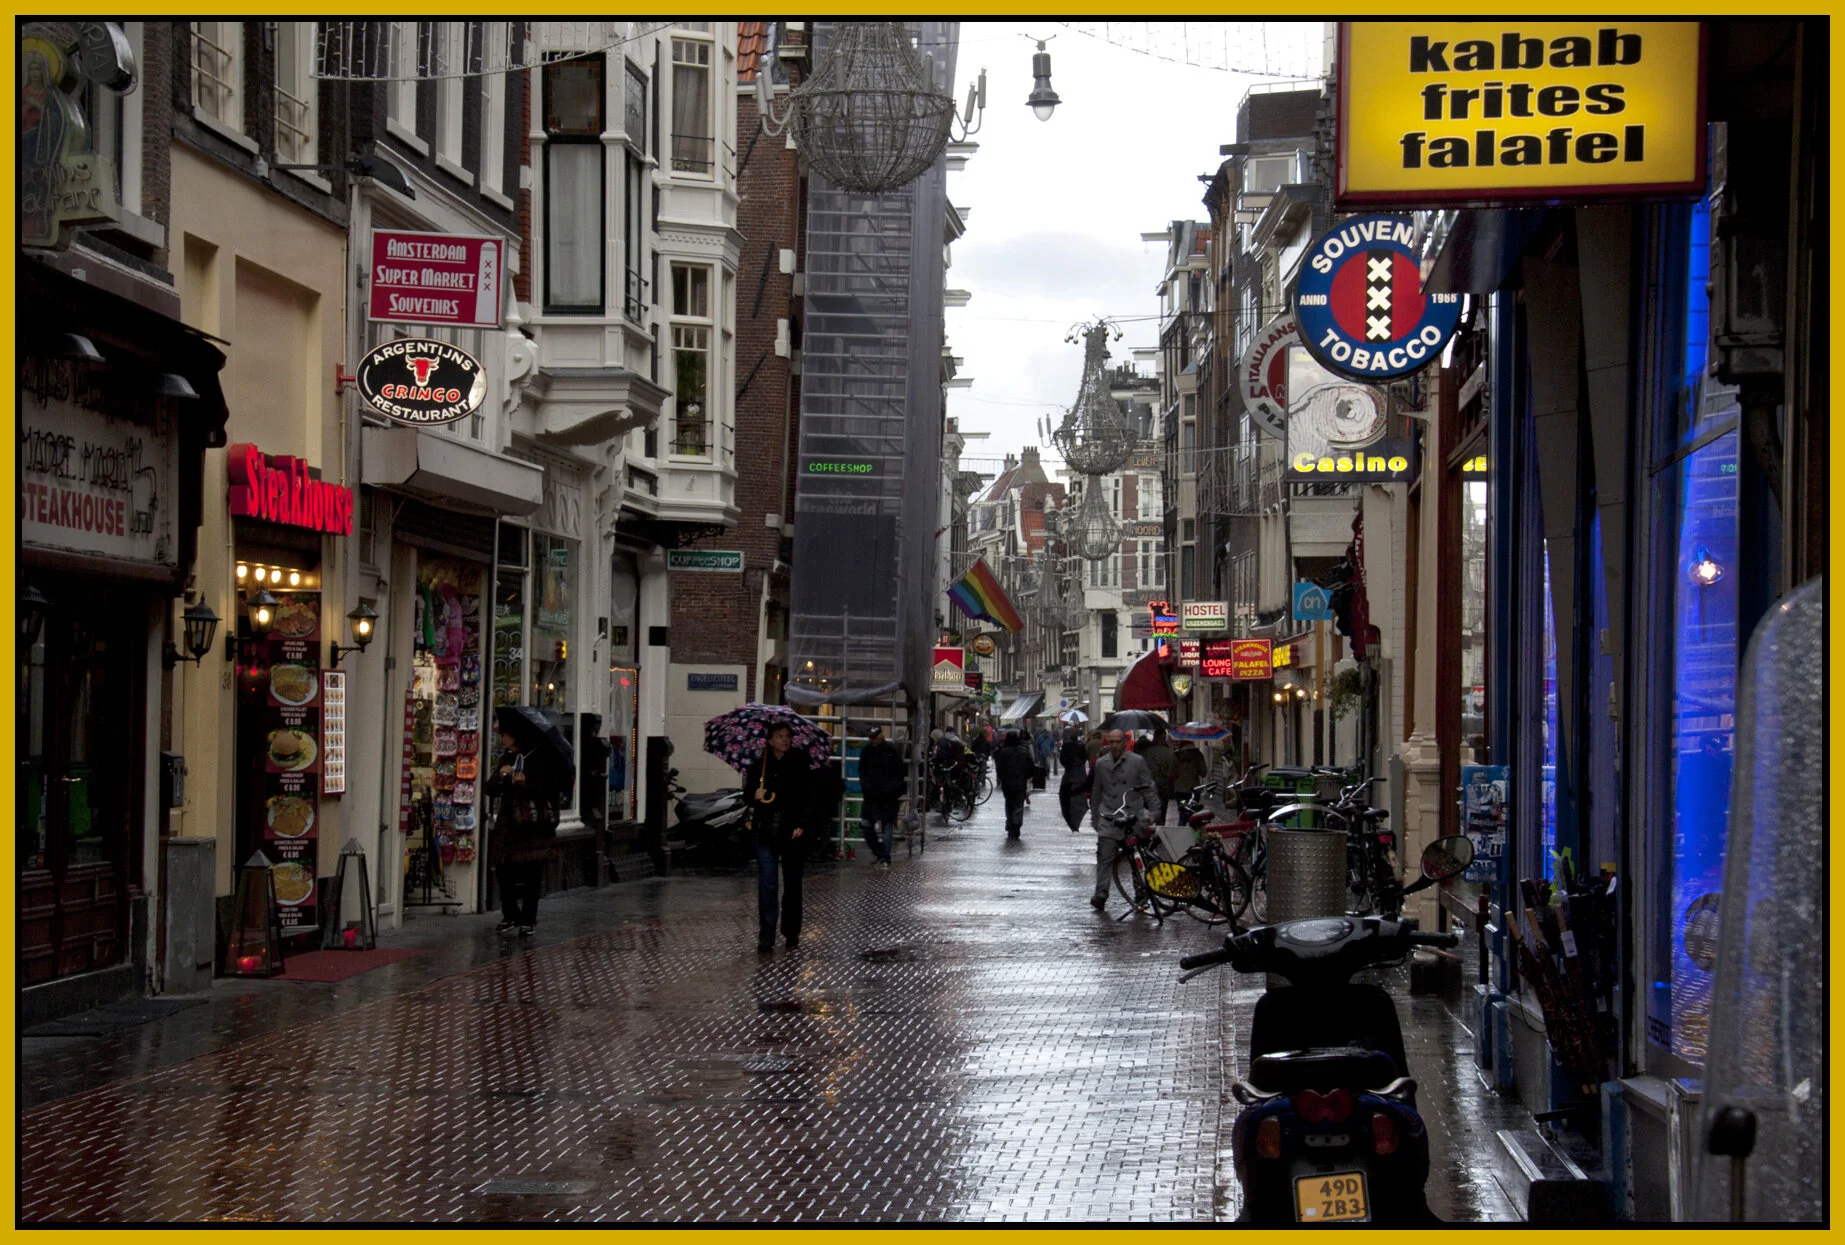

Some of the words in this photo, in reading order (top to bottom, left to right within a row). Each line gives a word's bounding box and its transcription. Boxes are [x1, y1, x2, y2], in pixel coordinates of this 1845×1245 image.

[1409, 28, 1642, 73] kabab
[1420, 82, 1626, 120] frites
[1399, 124, 1646, 169] falafel
[387, 238, 467, 261] AMSTERDAM
[1310, 220, 1414, 274] SOUVEN
[375, 265, 418, 285] SUPER
[420, 268, 476, 289] MARKET
[389, 293, 460, 315] SOUVENIRS
[1299, 294, 1327, 305] ANNO
[372, 342, 473, 371] ARGENTIJNS
[1319, 325, 1442, 372] TOBACCO
[381, 384, 461, 402] GRINGO
[1249, 385, 1270, 399] LA
[371, 394, 471, 421] RESTAURANT
[809, 462, 873, 473] COFFEESHOP
[1293, 452, 1408, 473] Casino
[246, 443, 354, 536] Steakhouse
[671, 555, 740, 567] COFFEESHOP
[1184, 605, 1225, 616] HOSTEL
[1208, 668, 1232, 676] CAFE
[1233, 660, 1270, 668] FALAFEL
[1239, 669, 1265, 677] PIZZA
[1319, 1178, 1359, 1197] 49D
[1321, 1199, 1362, 1218] ZB3
